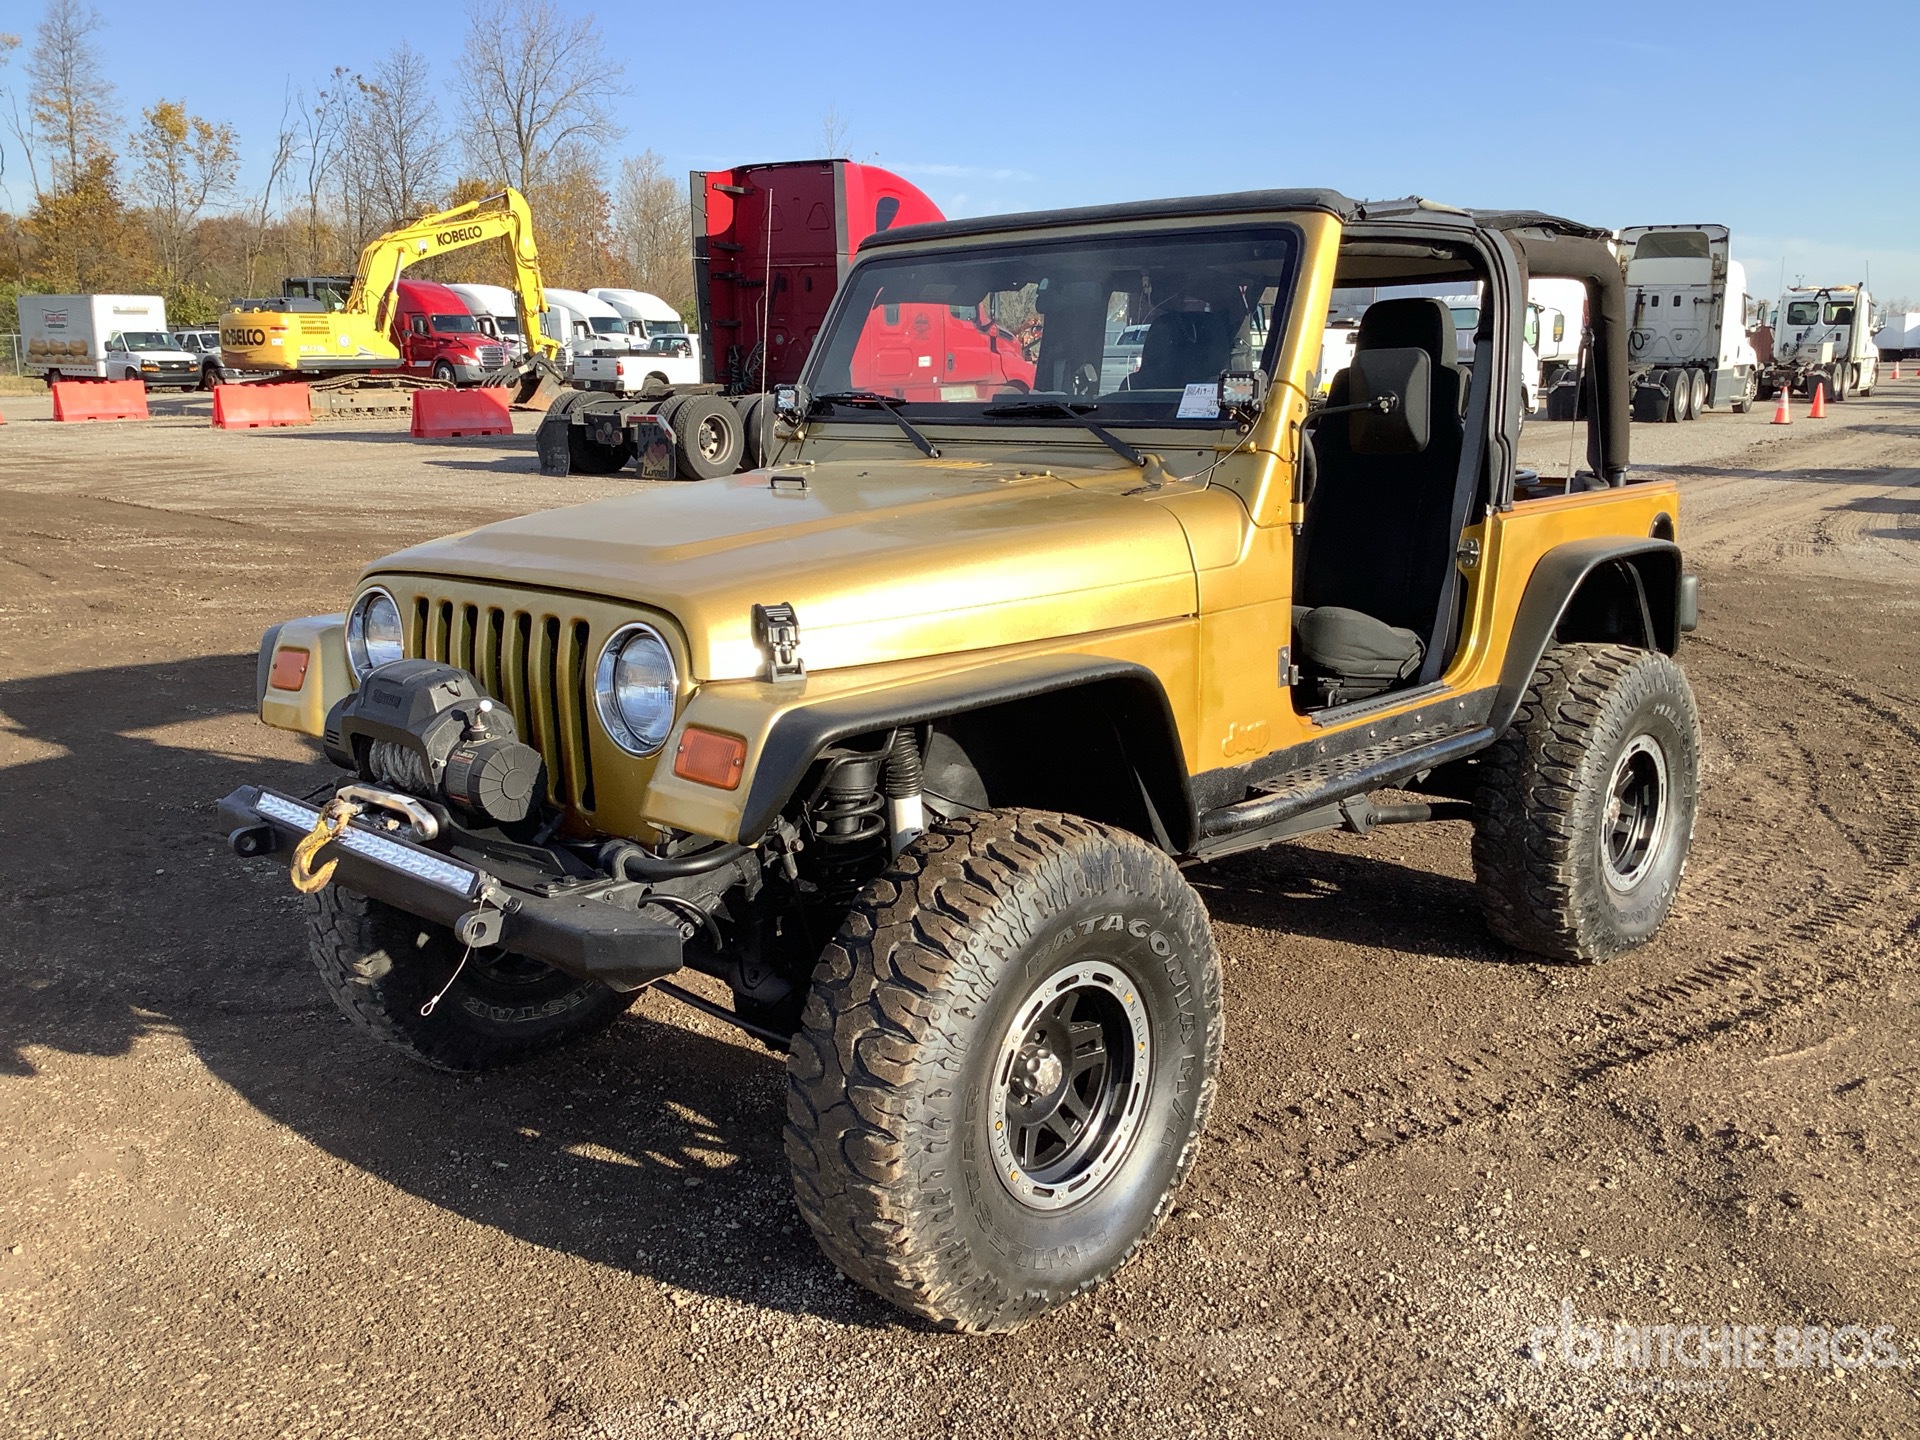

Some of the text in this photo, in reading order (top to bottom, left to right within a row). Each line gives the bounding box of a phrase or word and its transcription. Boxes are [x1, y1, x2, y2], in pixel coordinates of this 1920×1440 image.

[436, 226, 482, 246] KOBELCO
[1221, 720, 1270, 758] Jeep
[463, 980, 595, 1022] ESTAR
[1026, 912, 1196, 1044] PATAGONIA
[1123, 988, 1146, 1060] ION ALLOY
[994, 1110, 1021, 1185] ION ALLOY
